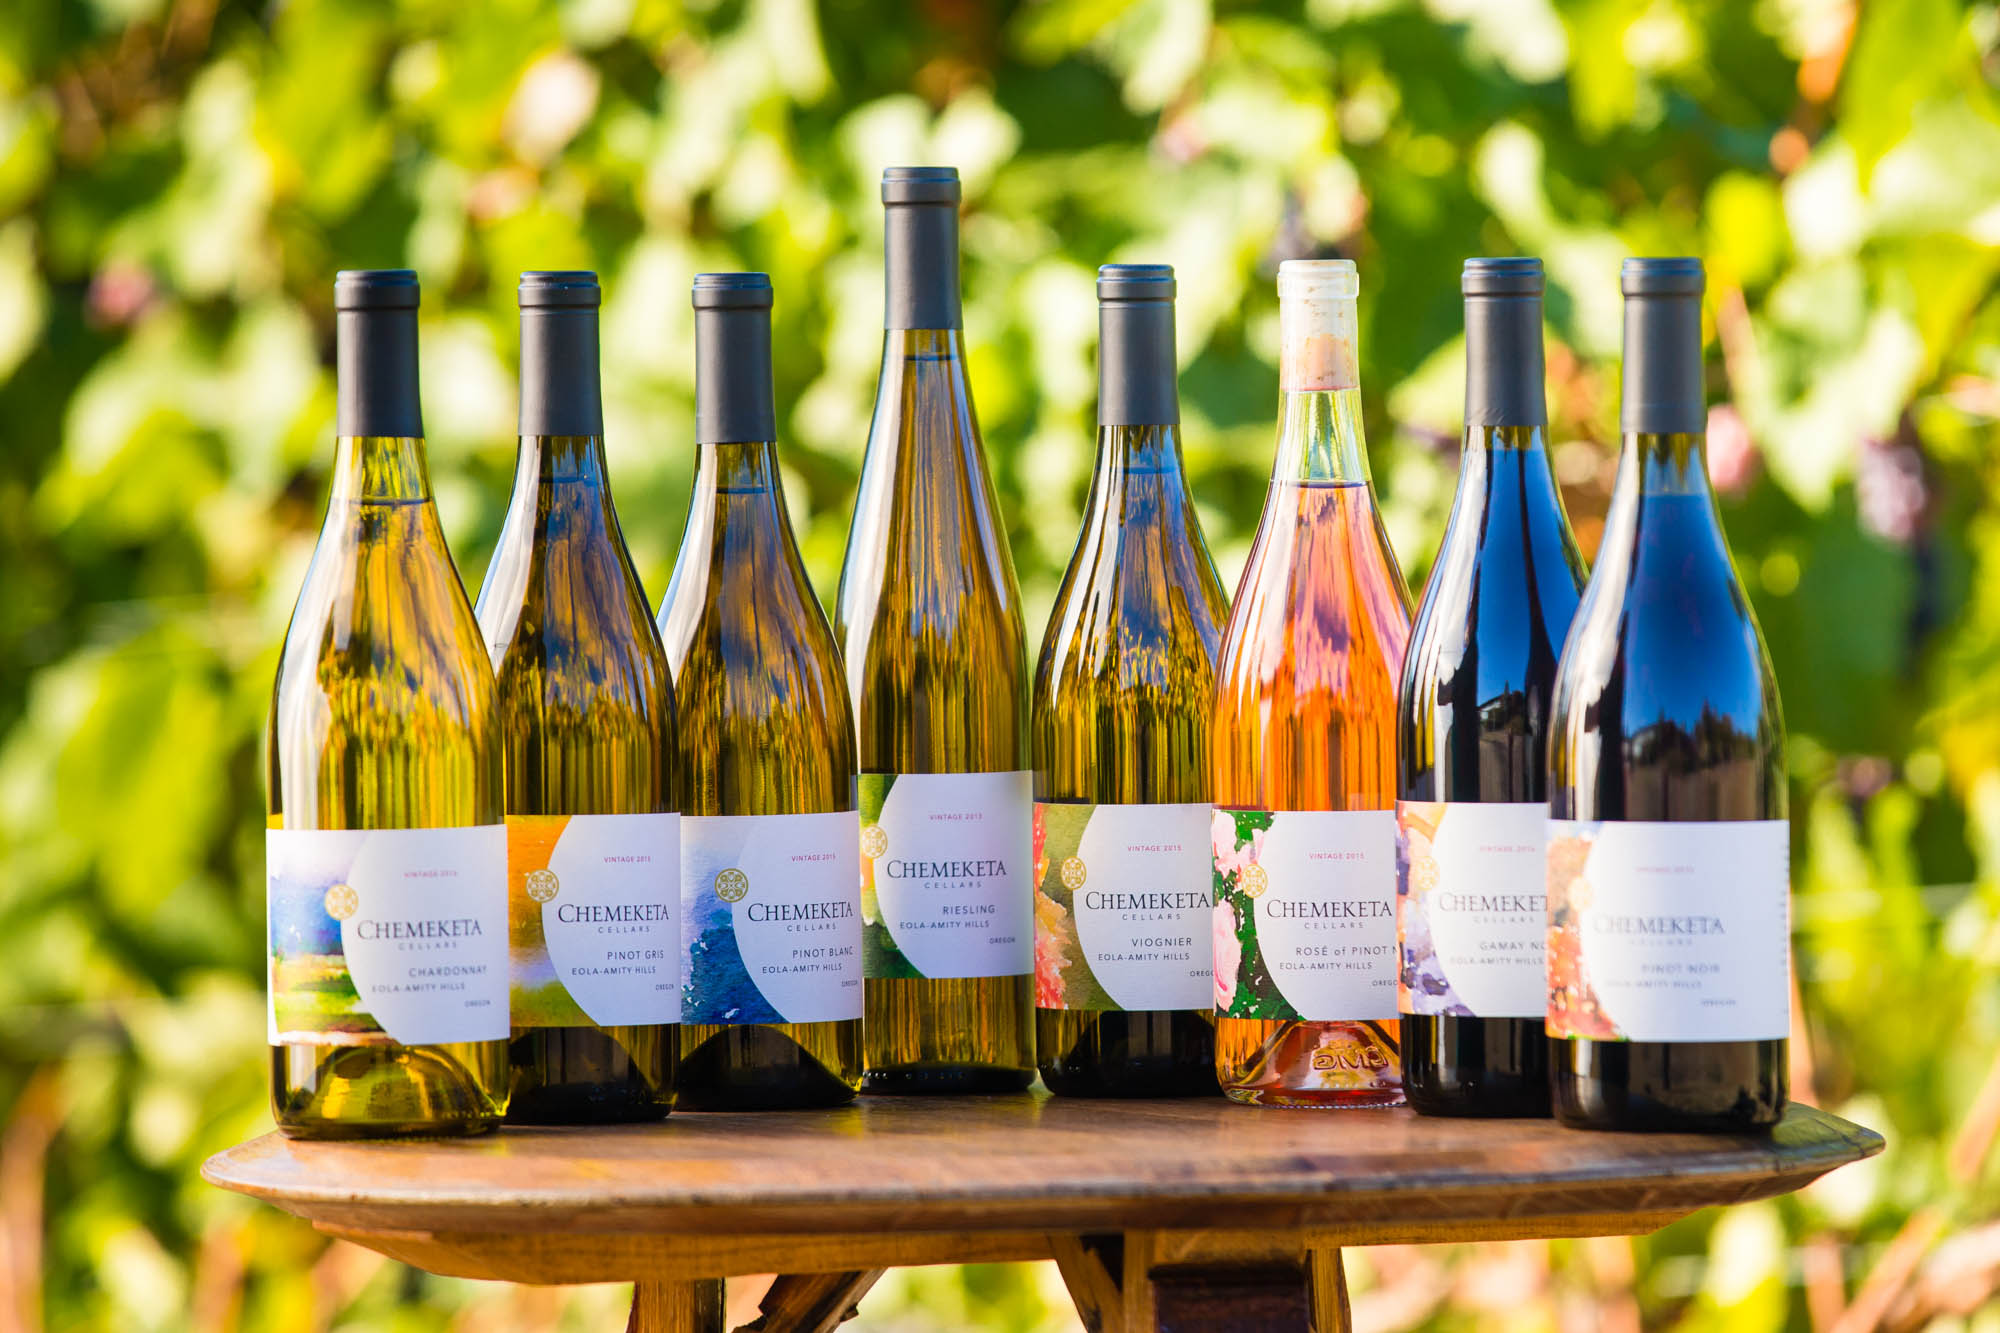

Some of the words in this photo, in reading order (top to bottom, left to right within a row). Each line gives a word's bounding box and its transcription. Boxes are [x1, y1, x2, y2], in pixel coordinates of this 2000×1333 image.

[887, 860, 1007, 879] CHEMEKETA
[1085, 891, 1210, 910] CHEMEKETA
[1440, 892, 1548, 912] CHEMEKET
[558, 904, 670, 923] CHEMEKETA
[748, 902, 854, 922] CHEMEKETA
[943, 905, 996, 915] RIESLING
[1266, 899, 1393, 918] CHEMEKETA
[357, 919, 482, 940] CHEMEKETA
[787, 923, 837, 932] CELLARS
[900, 921, 961, 929] EOLA-AMITY
[965, 920, 990, 928] HILLS
[1594, 915, 1726, 935] CHEMEKETA
[399, 942, 457, 951] CELLARS
[1132, 938, 1192, 947] VIOGNIER
[1479, 941, 1525, 950] GAMAY
[607, 951, 641, 960] PINOT
[644, 950, 664, 959] GRIS
[792, 949, 826, 959] PINOT
[829, 947, 853, 957] BLANC
[1295, 945, 1328, 956] ROSÉ
[1334, 947, 1346, 956] of
[1352, 946, 1387, 955] PINOT
[409, 965, 487, 978] CHARDONNAY
[571, 967, 632, 976] EOLA-AMITY
[635, 966, 656, 974] HILLS
[762, 965, 820, 974] EOLA-AMITY
[823, 963, 843, 971] HILLS
[1642, 964, 1683, 974] PINOT
[1688, 964, 1721, 974] NOIR
[372, 984, 436, 993] EOLA-AMITY
[440, 982, 465, 991] HILLS
